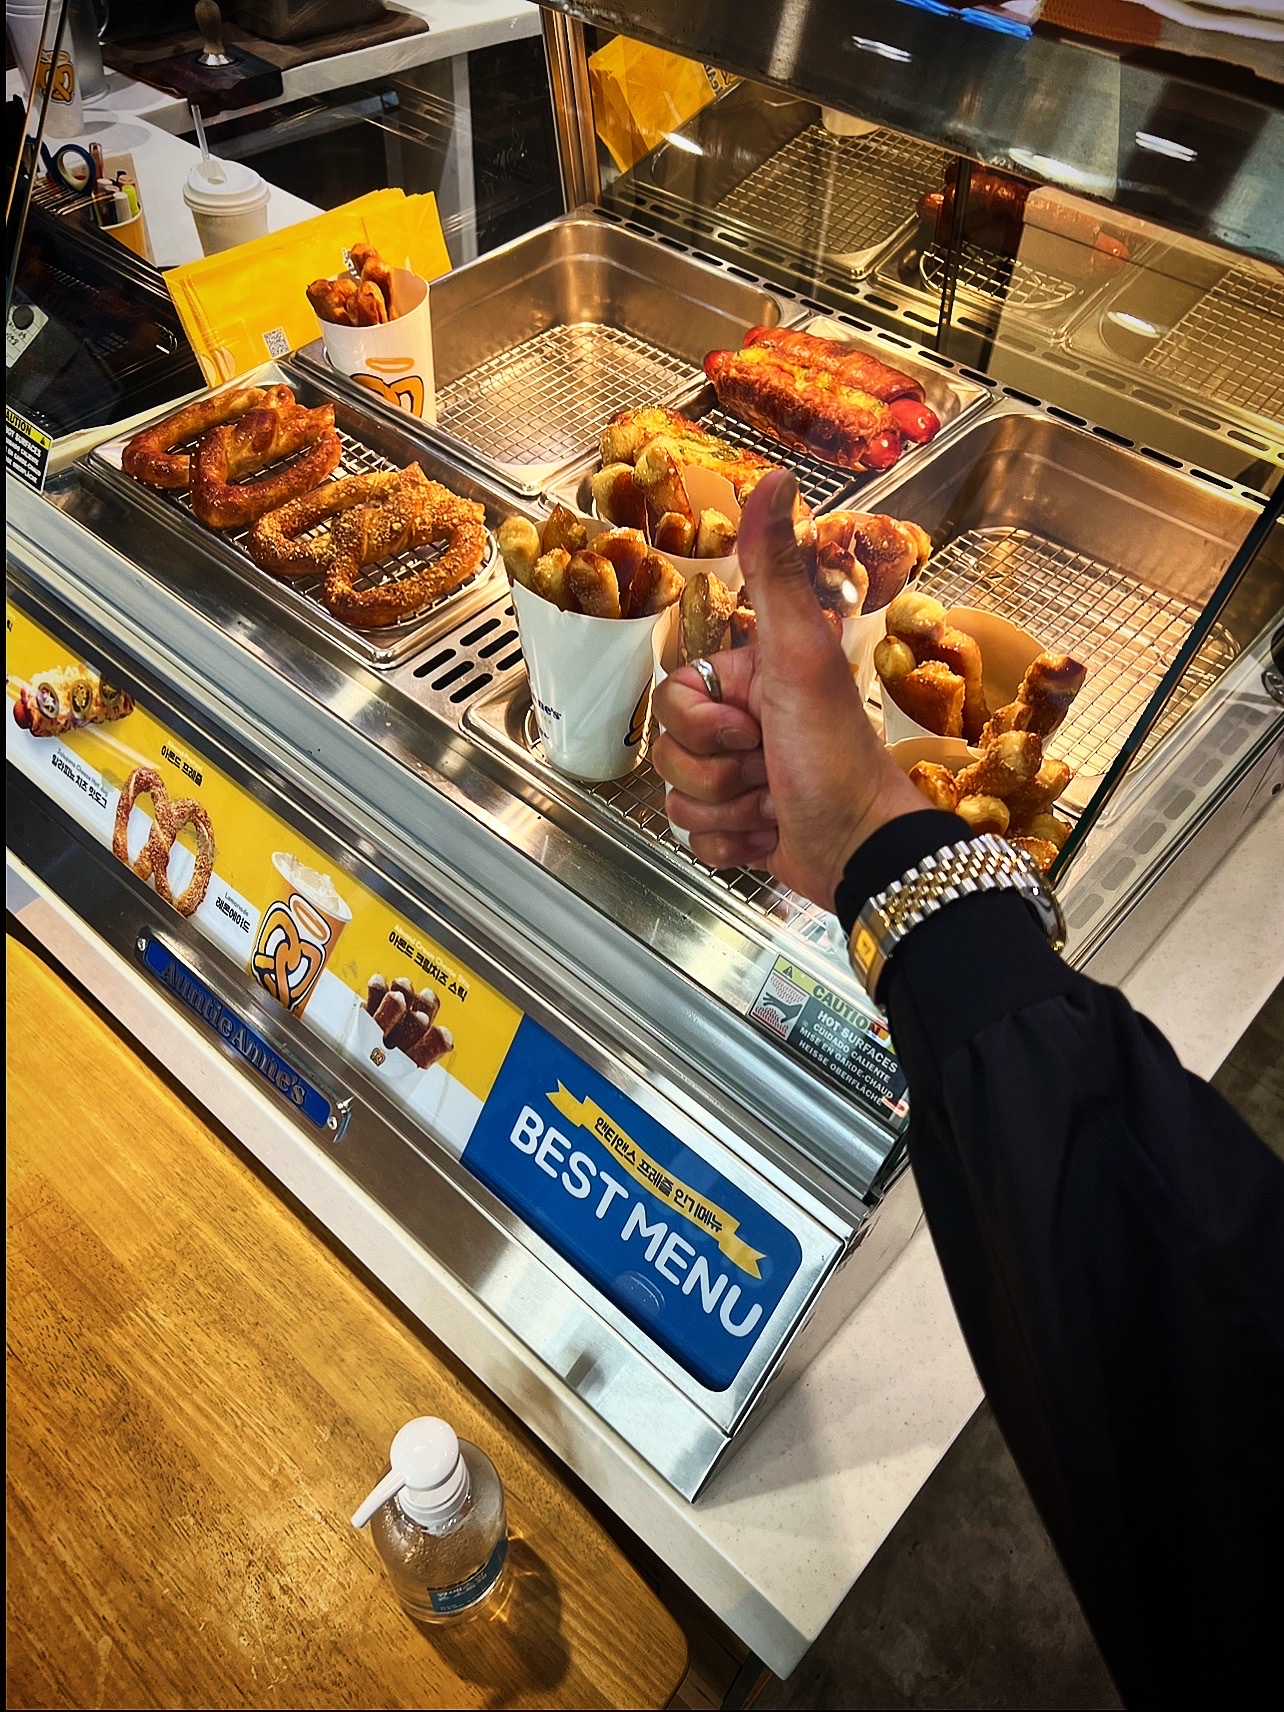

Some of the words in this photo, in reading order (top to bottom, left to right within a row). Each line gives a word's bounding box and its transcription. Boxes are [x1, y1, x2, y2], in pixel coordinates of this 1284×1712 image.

[6, 410, 32, 436] AUTION
[161, 745, 182, 769] 아몬드
[215, 896, 251, 934] 레몬에이드
[388, 931, 415, 959] 아몬드
[413, 952, 449, 987] 크림치즈
[447, 981, 468, 1003] 스틱
[160, 961, 236, 1037] Auntie
[231, 1026, 306, 1106] Anne's
[812, 984, 881, 1037] CAUTION
[798, 1040, 828, 1067] HEISSE
[799, 1026, 822, 1048] MISE
[821, 1040, 834, 1056] EN
[834, 1052, 894, 1100] GARDE-CHAUD
[813, 1023, 850, 1054] CUIDADO
[850, 1050, 891, 1084] CALIENTE
[817, 1010, 842, 1033] HOT
[840, 1027, 898, 1074] SURFACES
[594, 1116, 637, 1166] 앤티앤스
[636, 1158, 673, 1198] 프레즐
[672, 1188, 723, 1233] 인기메뉴
[509, 1104, 629, 1220] BEST
[620, 1201, 763, 1338] MENU
